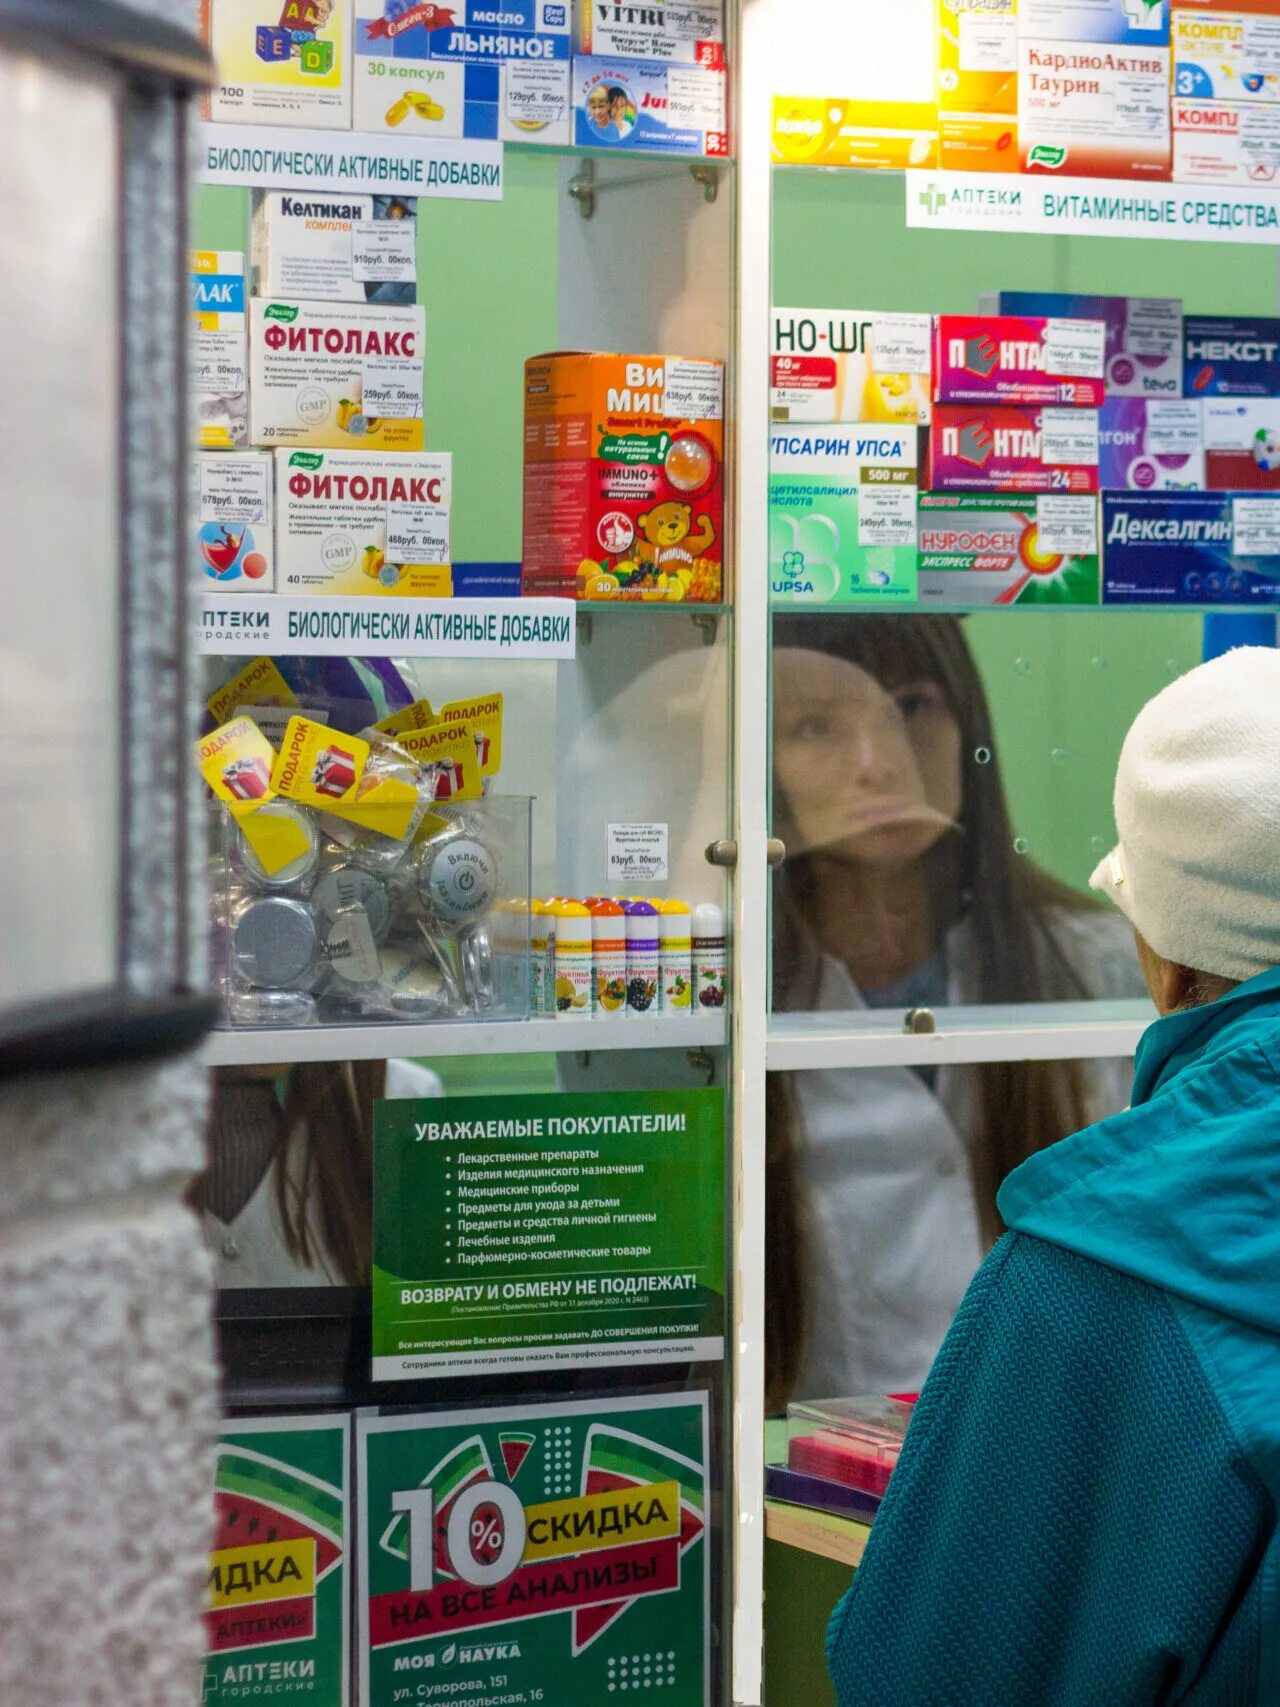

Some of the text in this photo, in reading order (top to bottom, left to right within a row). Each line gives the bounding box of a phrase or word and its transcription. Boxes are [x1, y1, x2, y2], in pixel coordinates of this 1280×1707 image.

[473, 11, 525, 25] масло
[448, 32, 555, 58] ЛЬНЯНОЕ
[307, 52, 320, 68] D
[1028, 49, 1163, 73] КардиоАктив
[368, 63, 445, 80] 30 капсул
[220, 87, 244, 98] 100
[1028, 74, 1099, 96] Таурин
[207, 147, 500, 188] БИОЛОГИЧЕСКИ АКТИВНЫЕ ДОБАВКИ
[281, 197, 362, 220] Келтикан
[952, 189, 1279, 229] АПТЕКИ ВИТАМИННЫЕ СРЕДСТВА
[264, 325, 415, 357] ФИТОЛАКС
[1187, 341, 1280, 363] НЕКСТ
[776, 358, 792, 369] 40
[1060, 384, 1076, 402] 12
[1143, 376, 1176, 392] teva
[263, 427, 275, 437] 20
[856, 438, 903, 458] УПСА
[598, 469, 659, 481] IMMUNO+
[869, 469, 910, 481] 500 мг
[1052, 471, 1071, 488] 24
[288, 473, 442, 503] ФИТОЛАКС
[1108, 513, 1233, 544] Дексалгин
[388, 535, 419, 546] 468руб.
[921, 531, 1016, 551] НУРОФЕН
[659, 549, 693, 564] IMMUNO
[921, 557, 1010, 568] ЭКСПРЕСС ФОРТЕ
[287, 575, 300, 585] 40
[597, 582, 611, 592] 30
[772, 581, 814, 592] UPSA
[200, 611, 571, 645] ПТЕКИ БИОЛОГИЧЕСКИ АКТИВНЫЕ ДОБАВКИ
[444, 701, 499, 722] ПОДАРОК
[278, 722, 309, 792] ПОДАРОК
[447, 852, 489, 874] Включи
[415, 1113, 687, 1142] УВАЖАЕМЫЕ ПОКУПАТЕЛИ!
[458, 1149, 599, 1165] Лекарственные препараты
[458, 1163, 644, 1181] Изделия медицинского назначения
[458, 1182, 579, 1198] Медицинские приборы
[458, 1197, 620, 1216] Предметы для ухода за детьми
[458, 1211, 657, 1232] Предметы и средства личной гигиены
[458, 1232, 555, 1249] Лечебные изделия
[458, 1244, 651, 1266] Парфюмерно-косметические товары
[401, 1274, 697, 1305] ВОЗВРАТУ И ОБМЕНУ НЕ ПОДЛЕЖАТ!
[399, 1323, 699, 1350] Все интересующие Вас вопросы просим задавать ДО СОВЕРШЕНИЯ ПОКУПКИ!
[402, 1360, 446, 1370] Сотрудники
[447, 1358, 472, 1367] аптеки
[473, 1356, 498, 1366] всегда
[498, 1355, 525, 1365] готовы
[525, 1353, 554, 1362] оказать
[555, 1351, 570, 1360] Вам
[570, 1348, 642, 1360] профессиональную
[527, 1498, 669, 1545] СКИДКА
[390, 1557, 657, 1628] НА ВСЕ АНАЛИЗЫ
[394, 1654, 435, 1671] МОЯ
[459, 1645, 521, 1664] НАУКА
[223, 1659, 315, 1684] АПТЕКИ
[222, 1681, 314, 1698] городские
[394, 1675, 507, 1701] ул. Суворова, 151
[530, 1689, 544, 1701] 16
